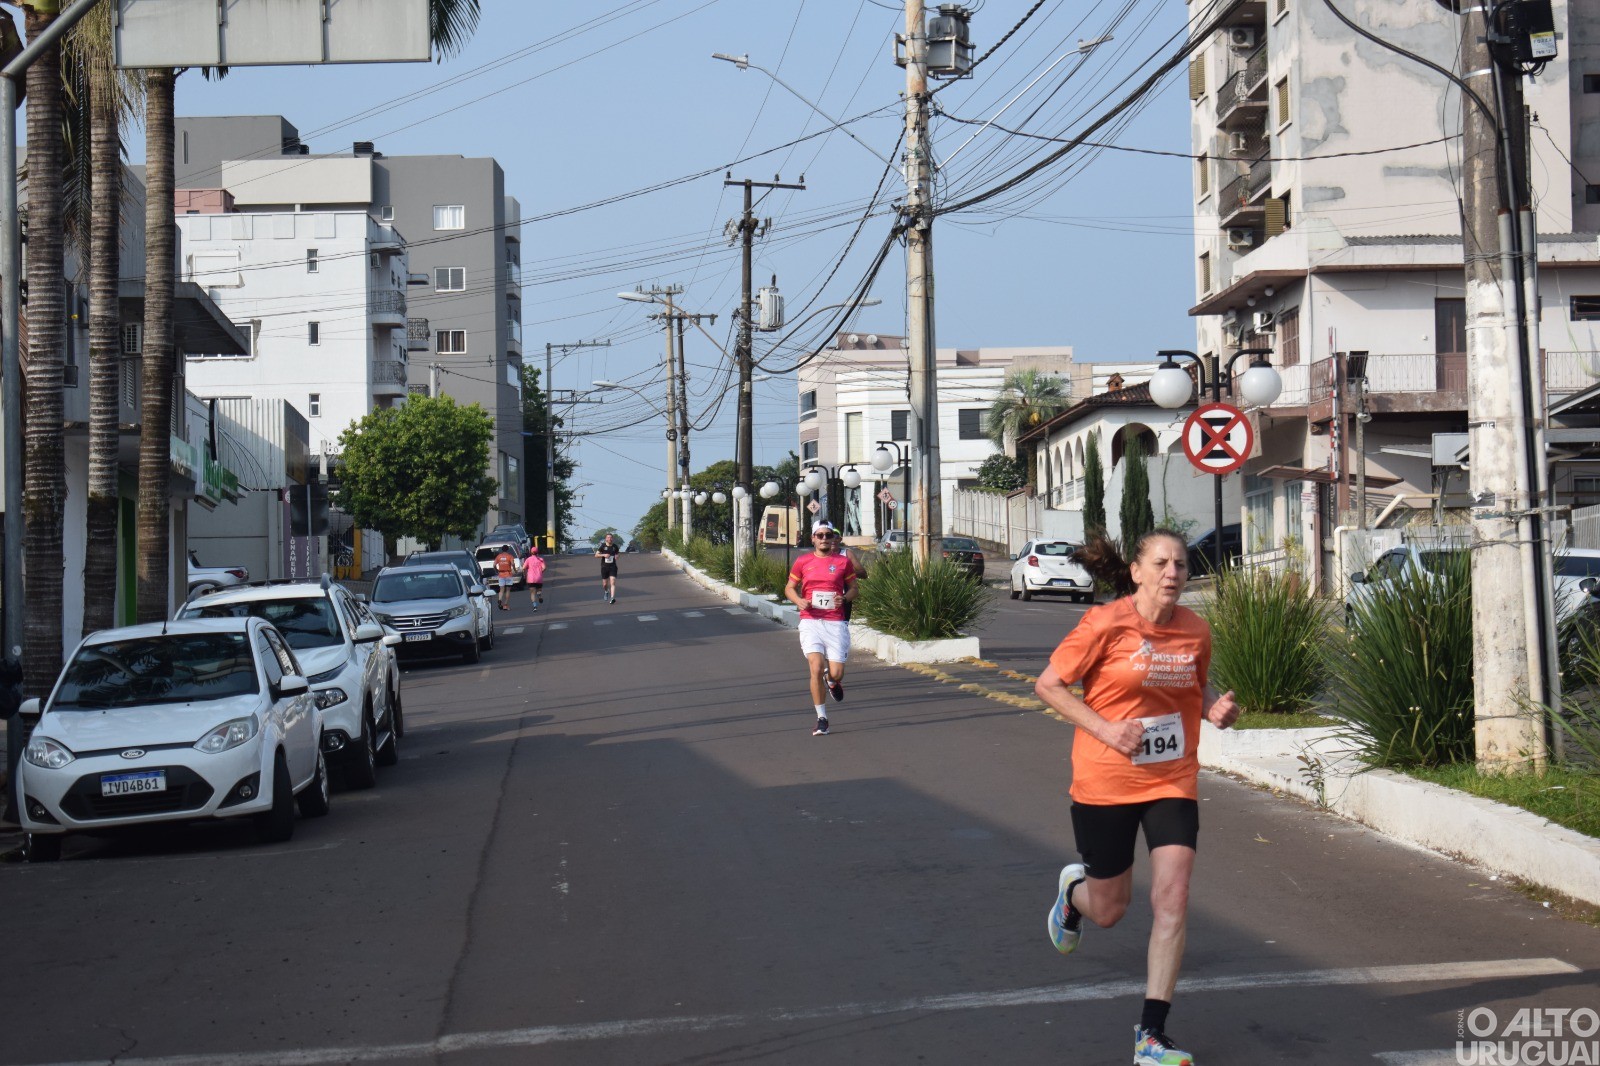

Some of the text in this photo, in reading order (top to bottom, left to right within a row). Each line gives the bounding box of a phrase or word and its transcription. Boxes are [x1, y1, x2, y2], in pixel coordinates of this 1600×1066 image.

[1132, 663, 1146, 671] 20
[1147, 664, 1171, 672] ANOS
[1147, 672, 1191, 680] FREDERICO
[1141, 680, 1195, 688] WESTPHALEN
[1142, 734, 1178, 756] 194
[107, 778, 159, 794] IVD4B61
